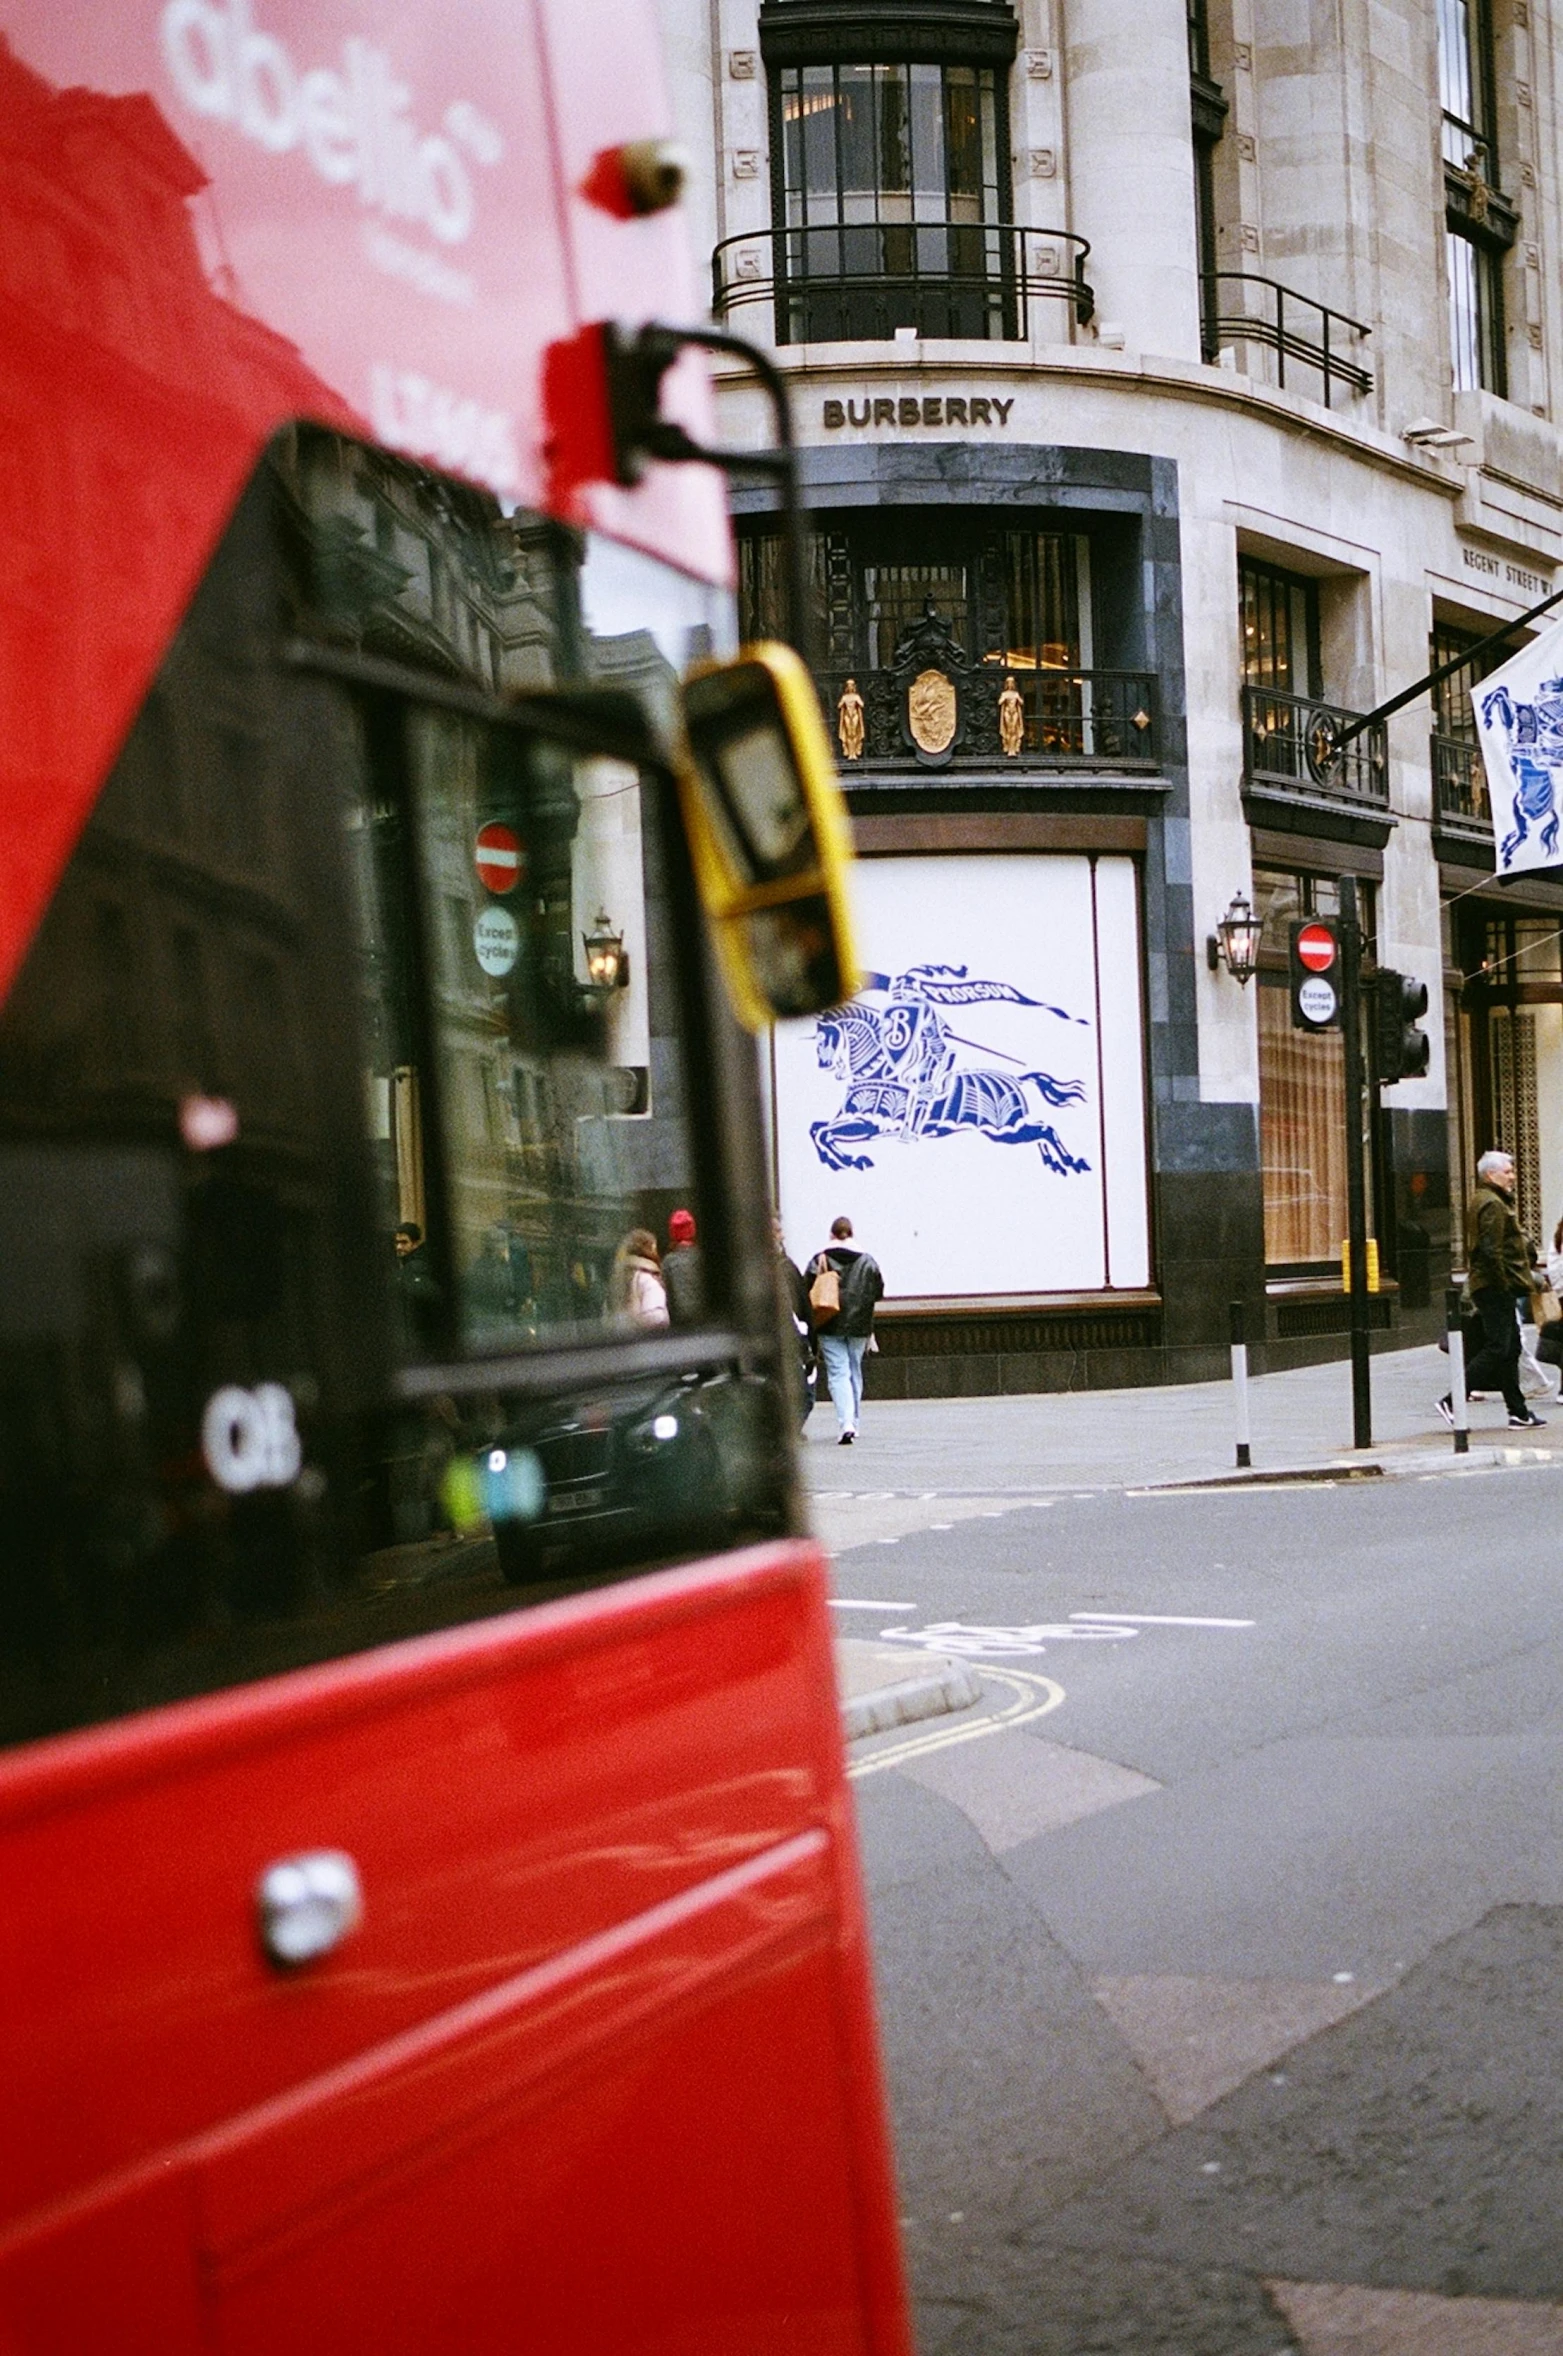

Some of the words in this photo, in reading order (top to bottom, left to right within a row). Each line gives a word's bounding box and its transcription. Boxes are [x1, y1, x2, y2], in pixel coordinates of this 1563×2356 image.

[823, 398, 1015, 429] BURBERRY
[1463, 548, 1499, 577] REGENT
[1506, 565, 1538, 593] STREET
[924, 983, 1020, 1003] PRORSUM
[1302, 990, 1332, 1001] Except
[1304, 1002, 1331, 1012] cycles
